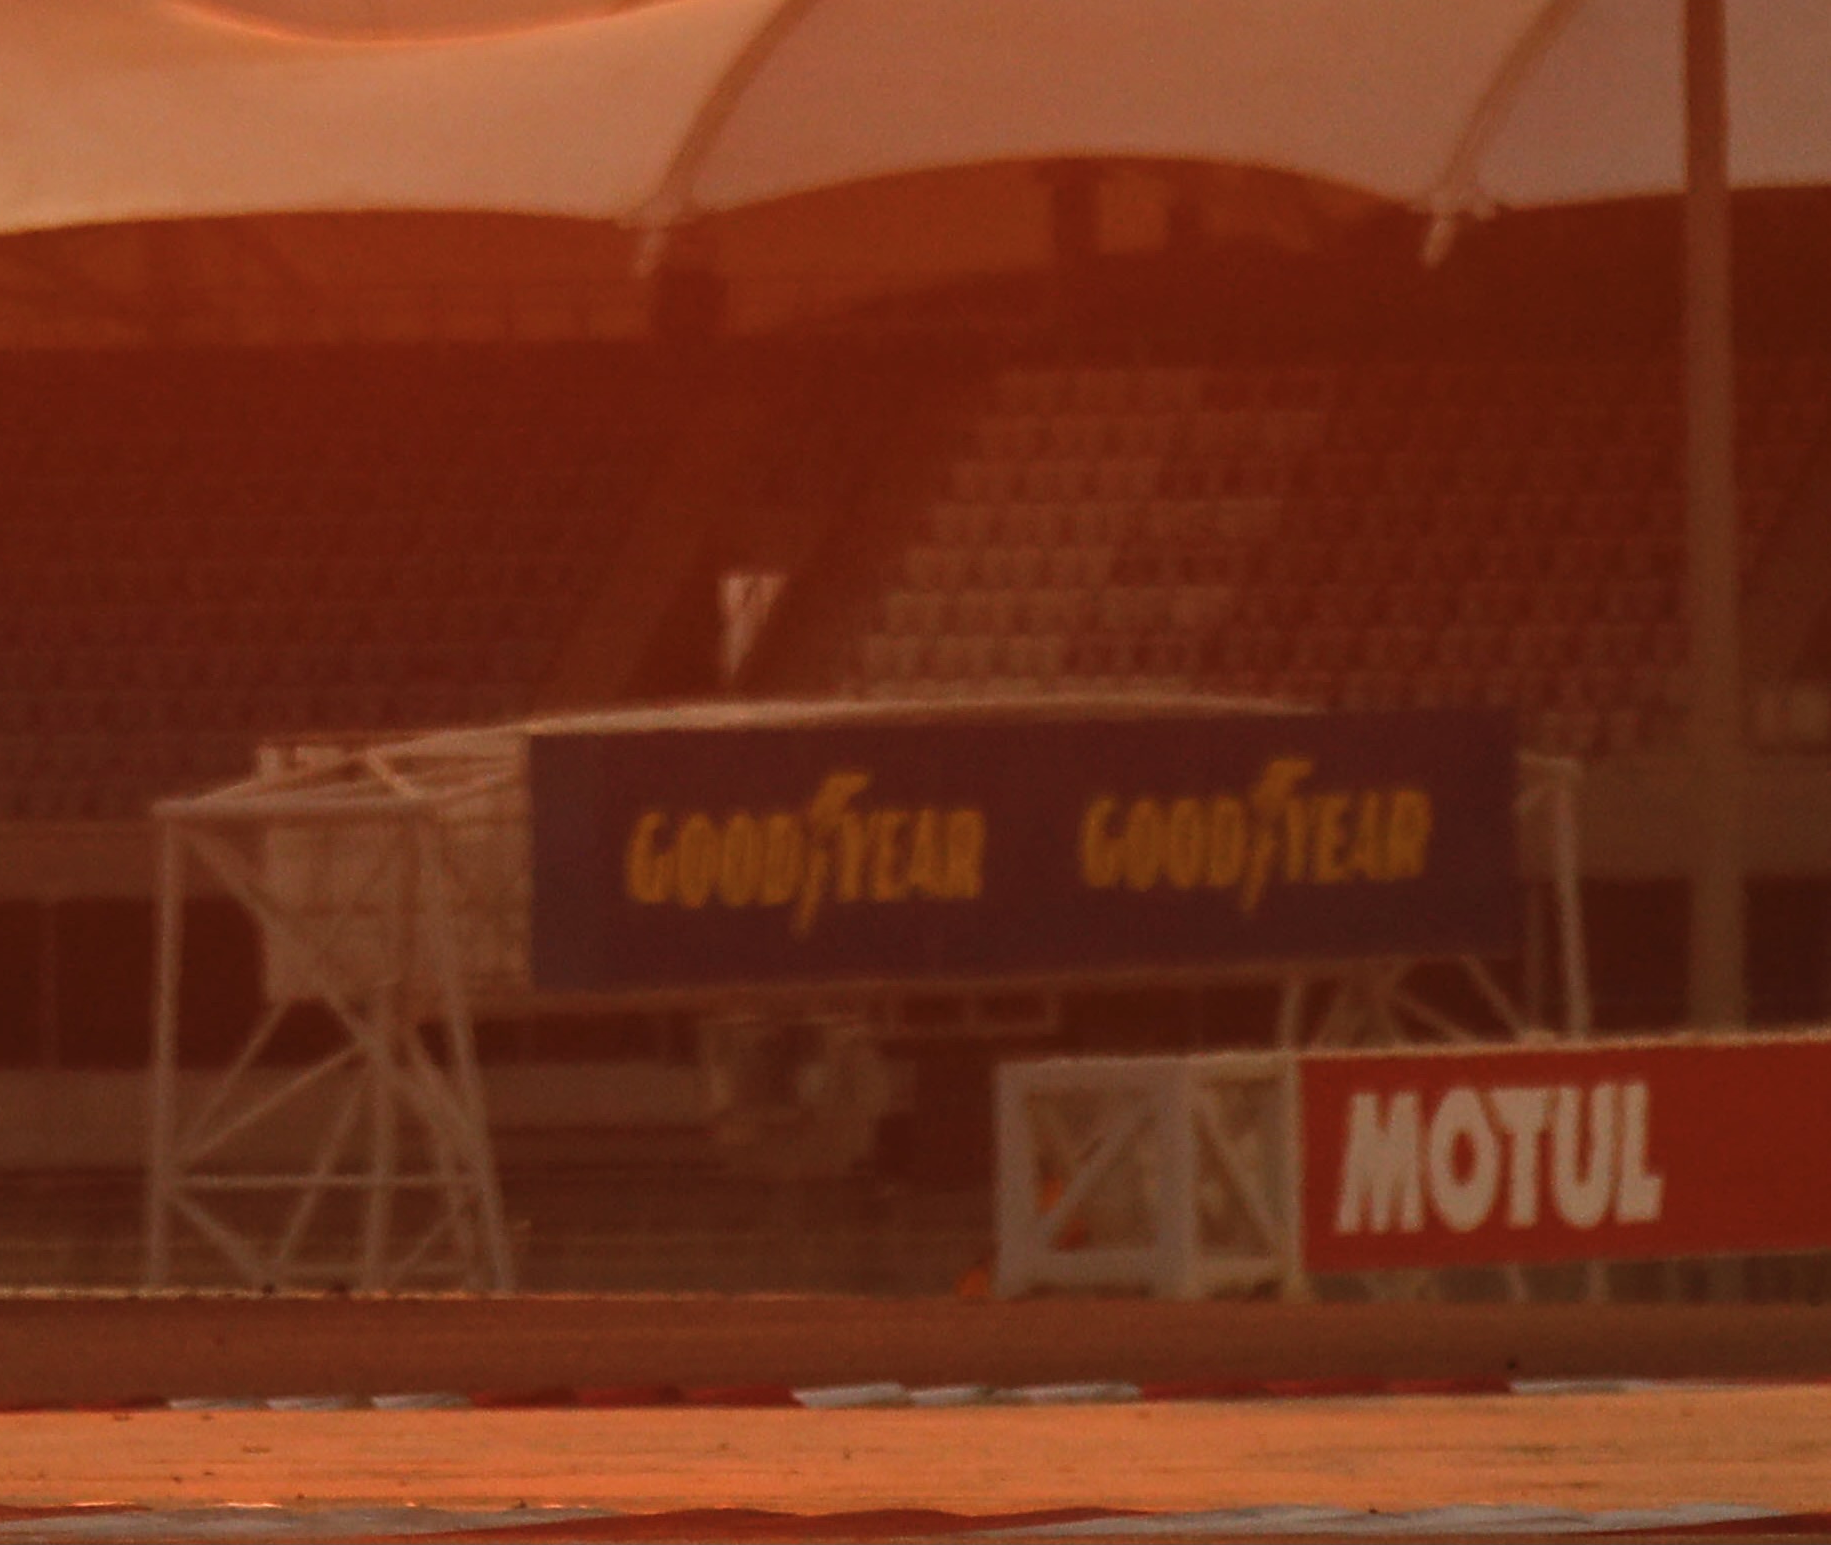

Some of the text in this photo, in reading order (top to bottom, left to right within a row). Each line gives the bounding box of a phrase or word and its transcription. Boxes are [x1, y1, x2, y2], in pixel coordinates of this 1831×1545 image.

[626, 789, 1434, 908] GOODYEAR GOODYEAR
[1336, 1082, 1664, 1235] MOTUL
